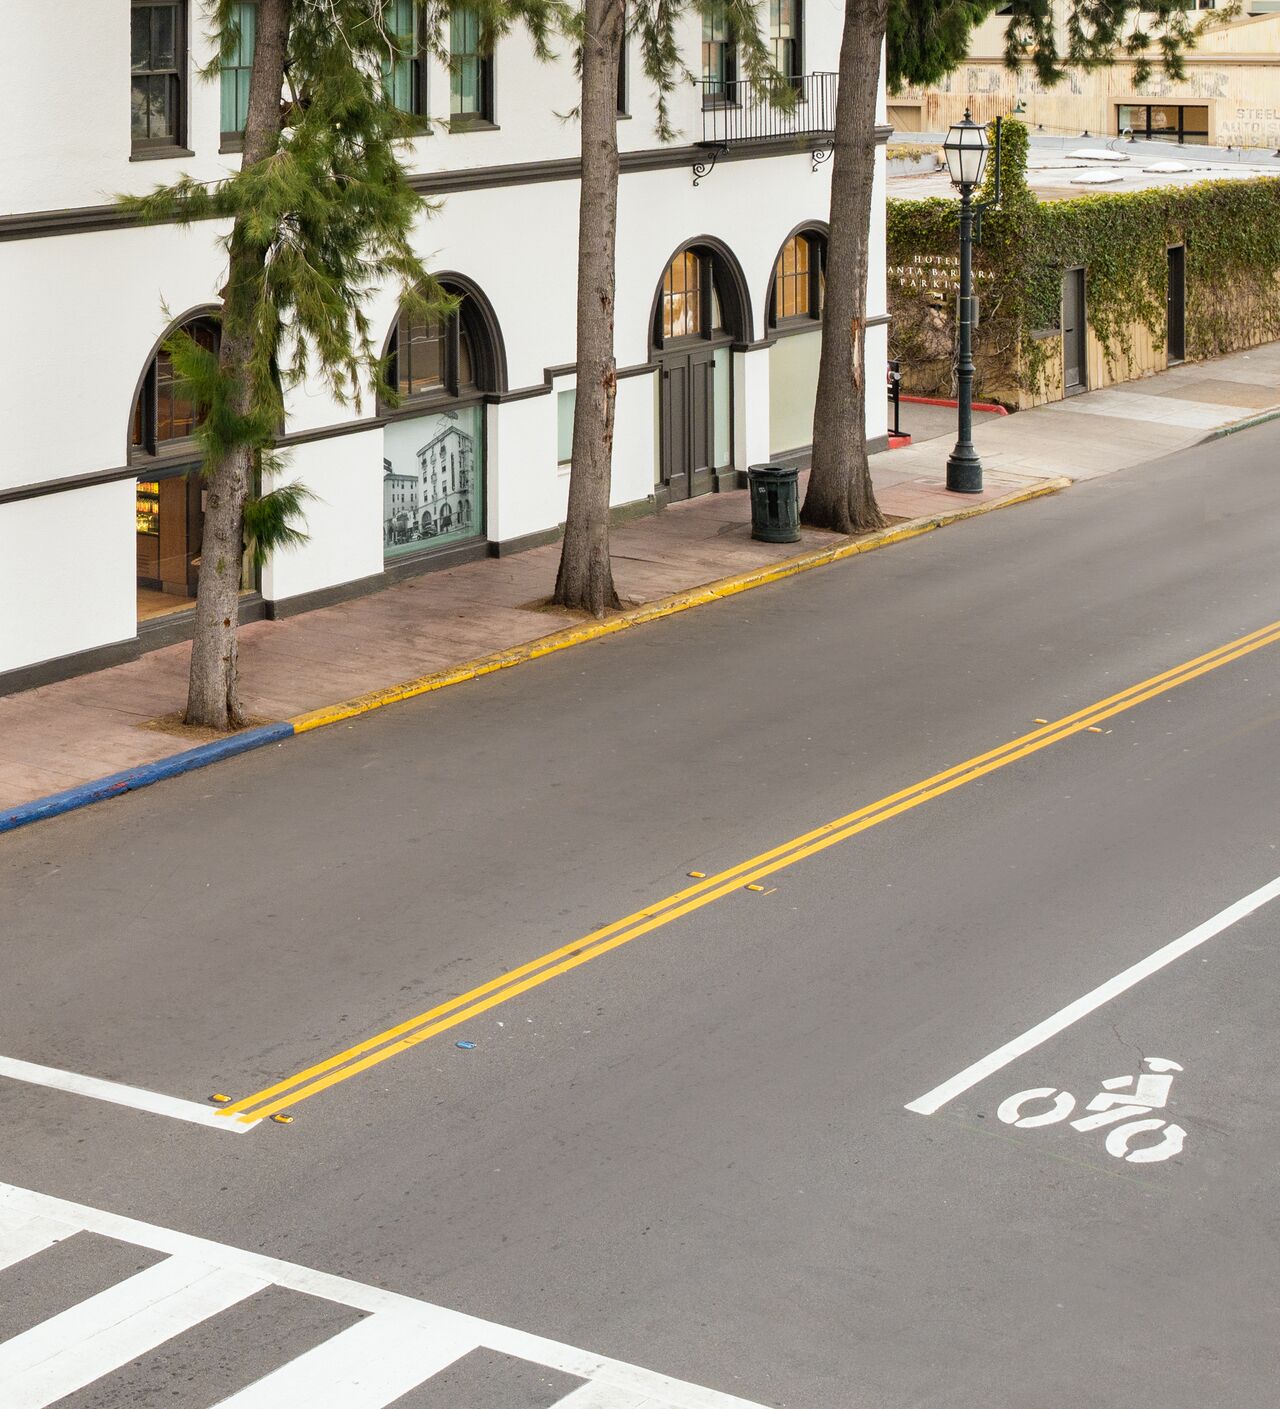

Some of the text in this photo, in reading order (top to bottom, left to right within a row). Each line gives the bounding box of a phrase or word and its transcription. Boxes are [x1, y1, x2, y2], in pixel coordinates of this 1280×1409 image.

[914, 255, 960, 265] HOTEL
[887, 266, 994, 279] ANTA BARARA
[900, 278, 976, 293] PARKIN
